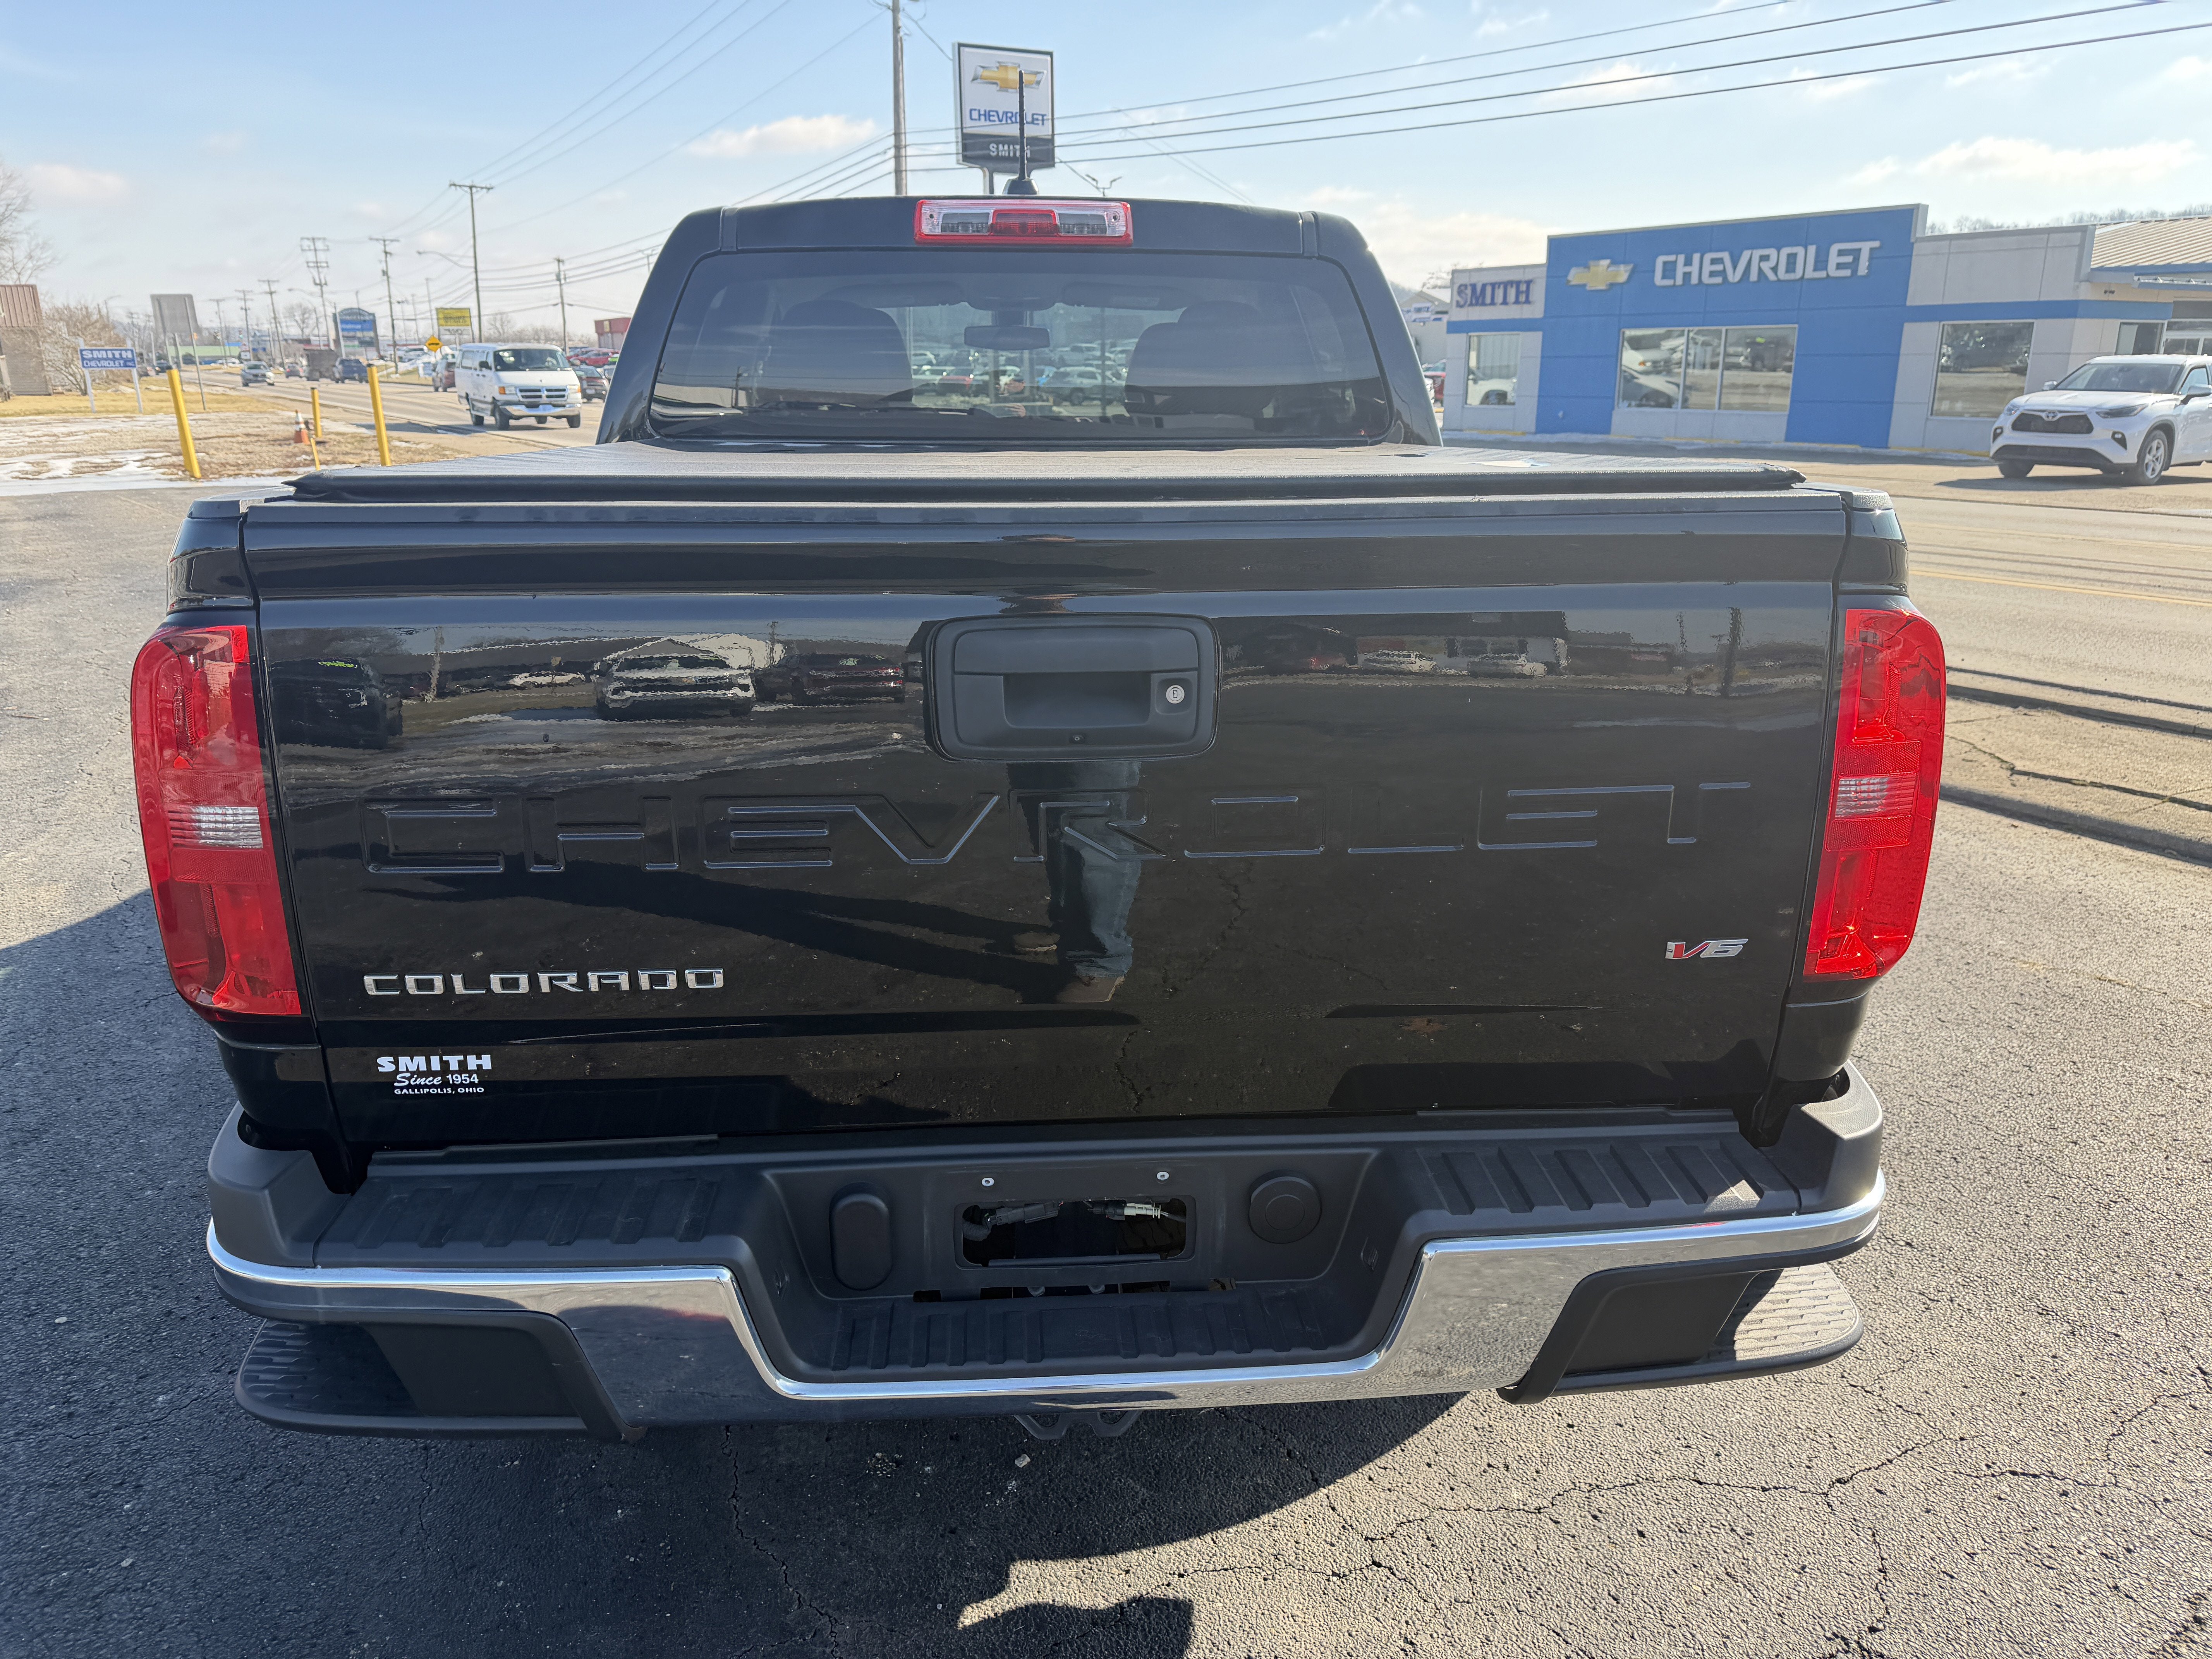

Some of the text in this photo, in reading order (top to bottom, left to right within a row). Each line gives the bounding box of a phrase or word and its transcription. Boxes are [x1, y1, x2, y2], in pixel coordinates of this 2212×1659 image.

[1654, 240, 1881, 287] CHEVROLET
[1455, 279, 1533, 308] SMITH
[82, 350, 132, 358] SMITH
[358, 769, 1752, 874] CHEVROLET
[1665, 939, 1749, 960] V6
[363, 967, 724, 996] COLORADO
[377, 1054, 492, 1072] SMITH
[393, 1073, 479, 1086] Since 1954
